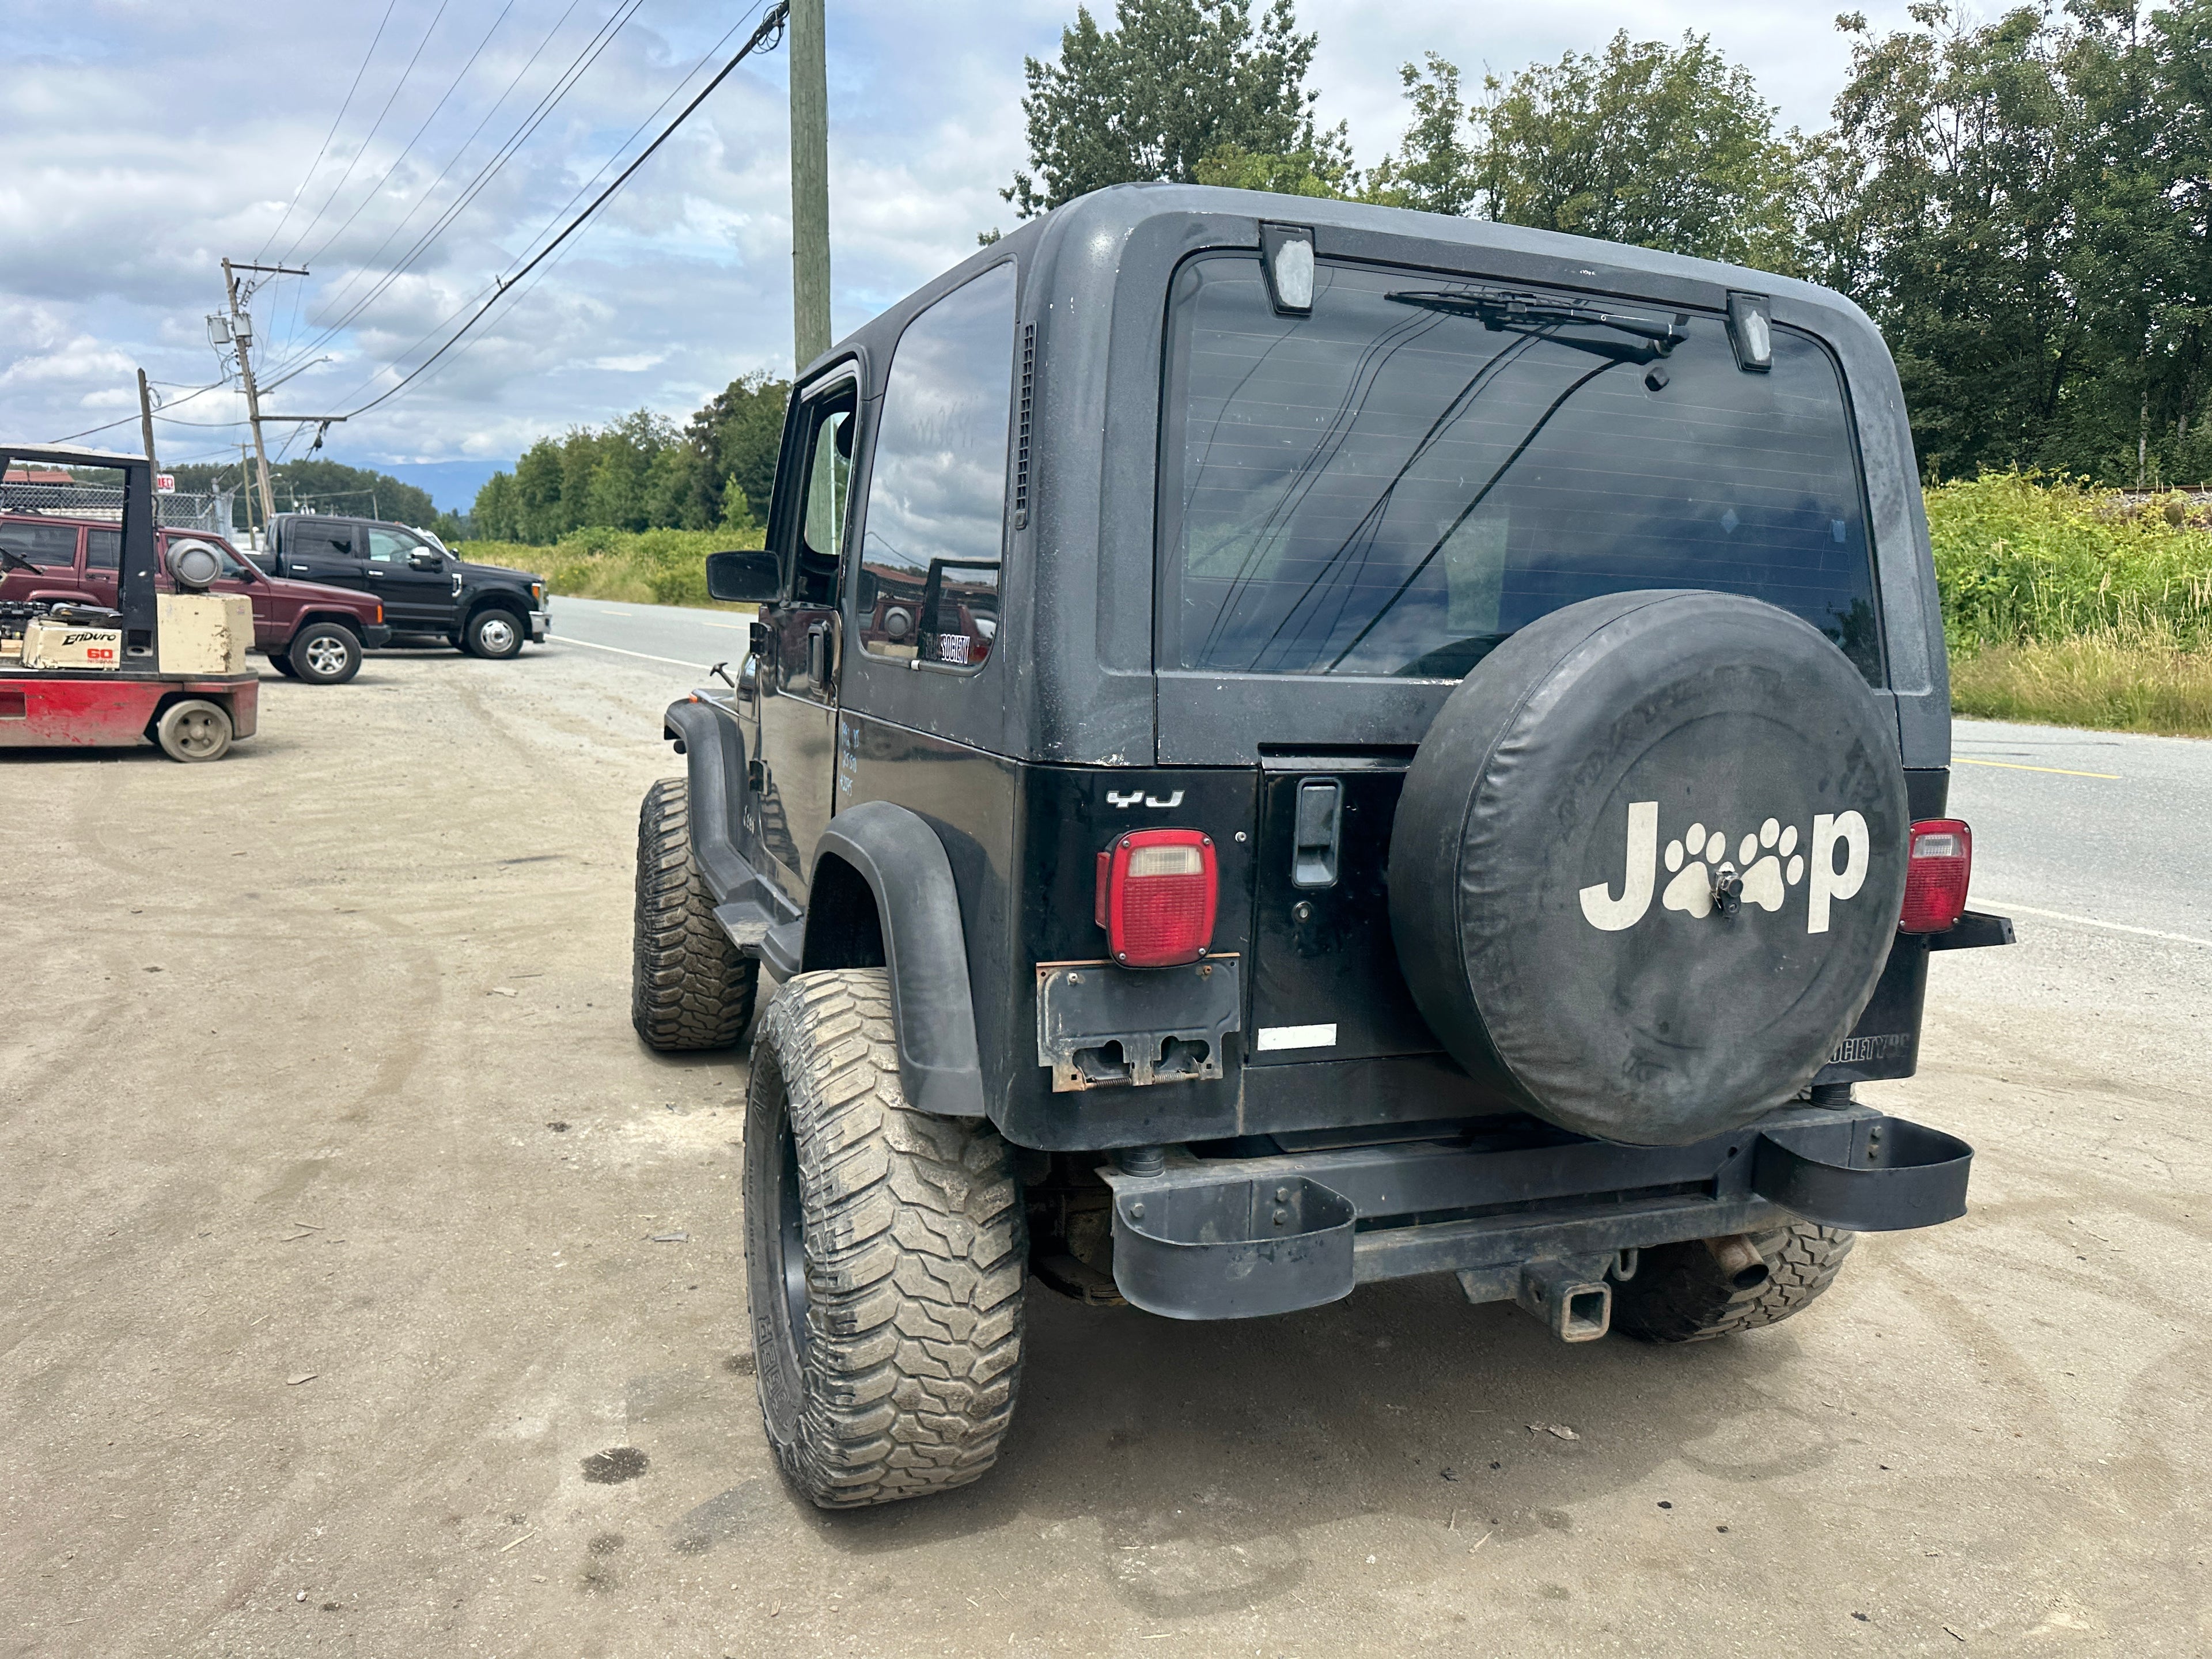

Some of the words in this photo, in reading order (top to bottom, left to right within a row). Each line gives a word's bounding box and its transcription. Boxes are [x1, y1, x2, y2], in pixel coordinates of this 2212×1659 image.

[87, 649, 113, 658] 60
[940, 634, 971, 664] SOCIETY
[1106, 790, 1185, 808] YJ
